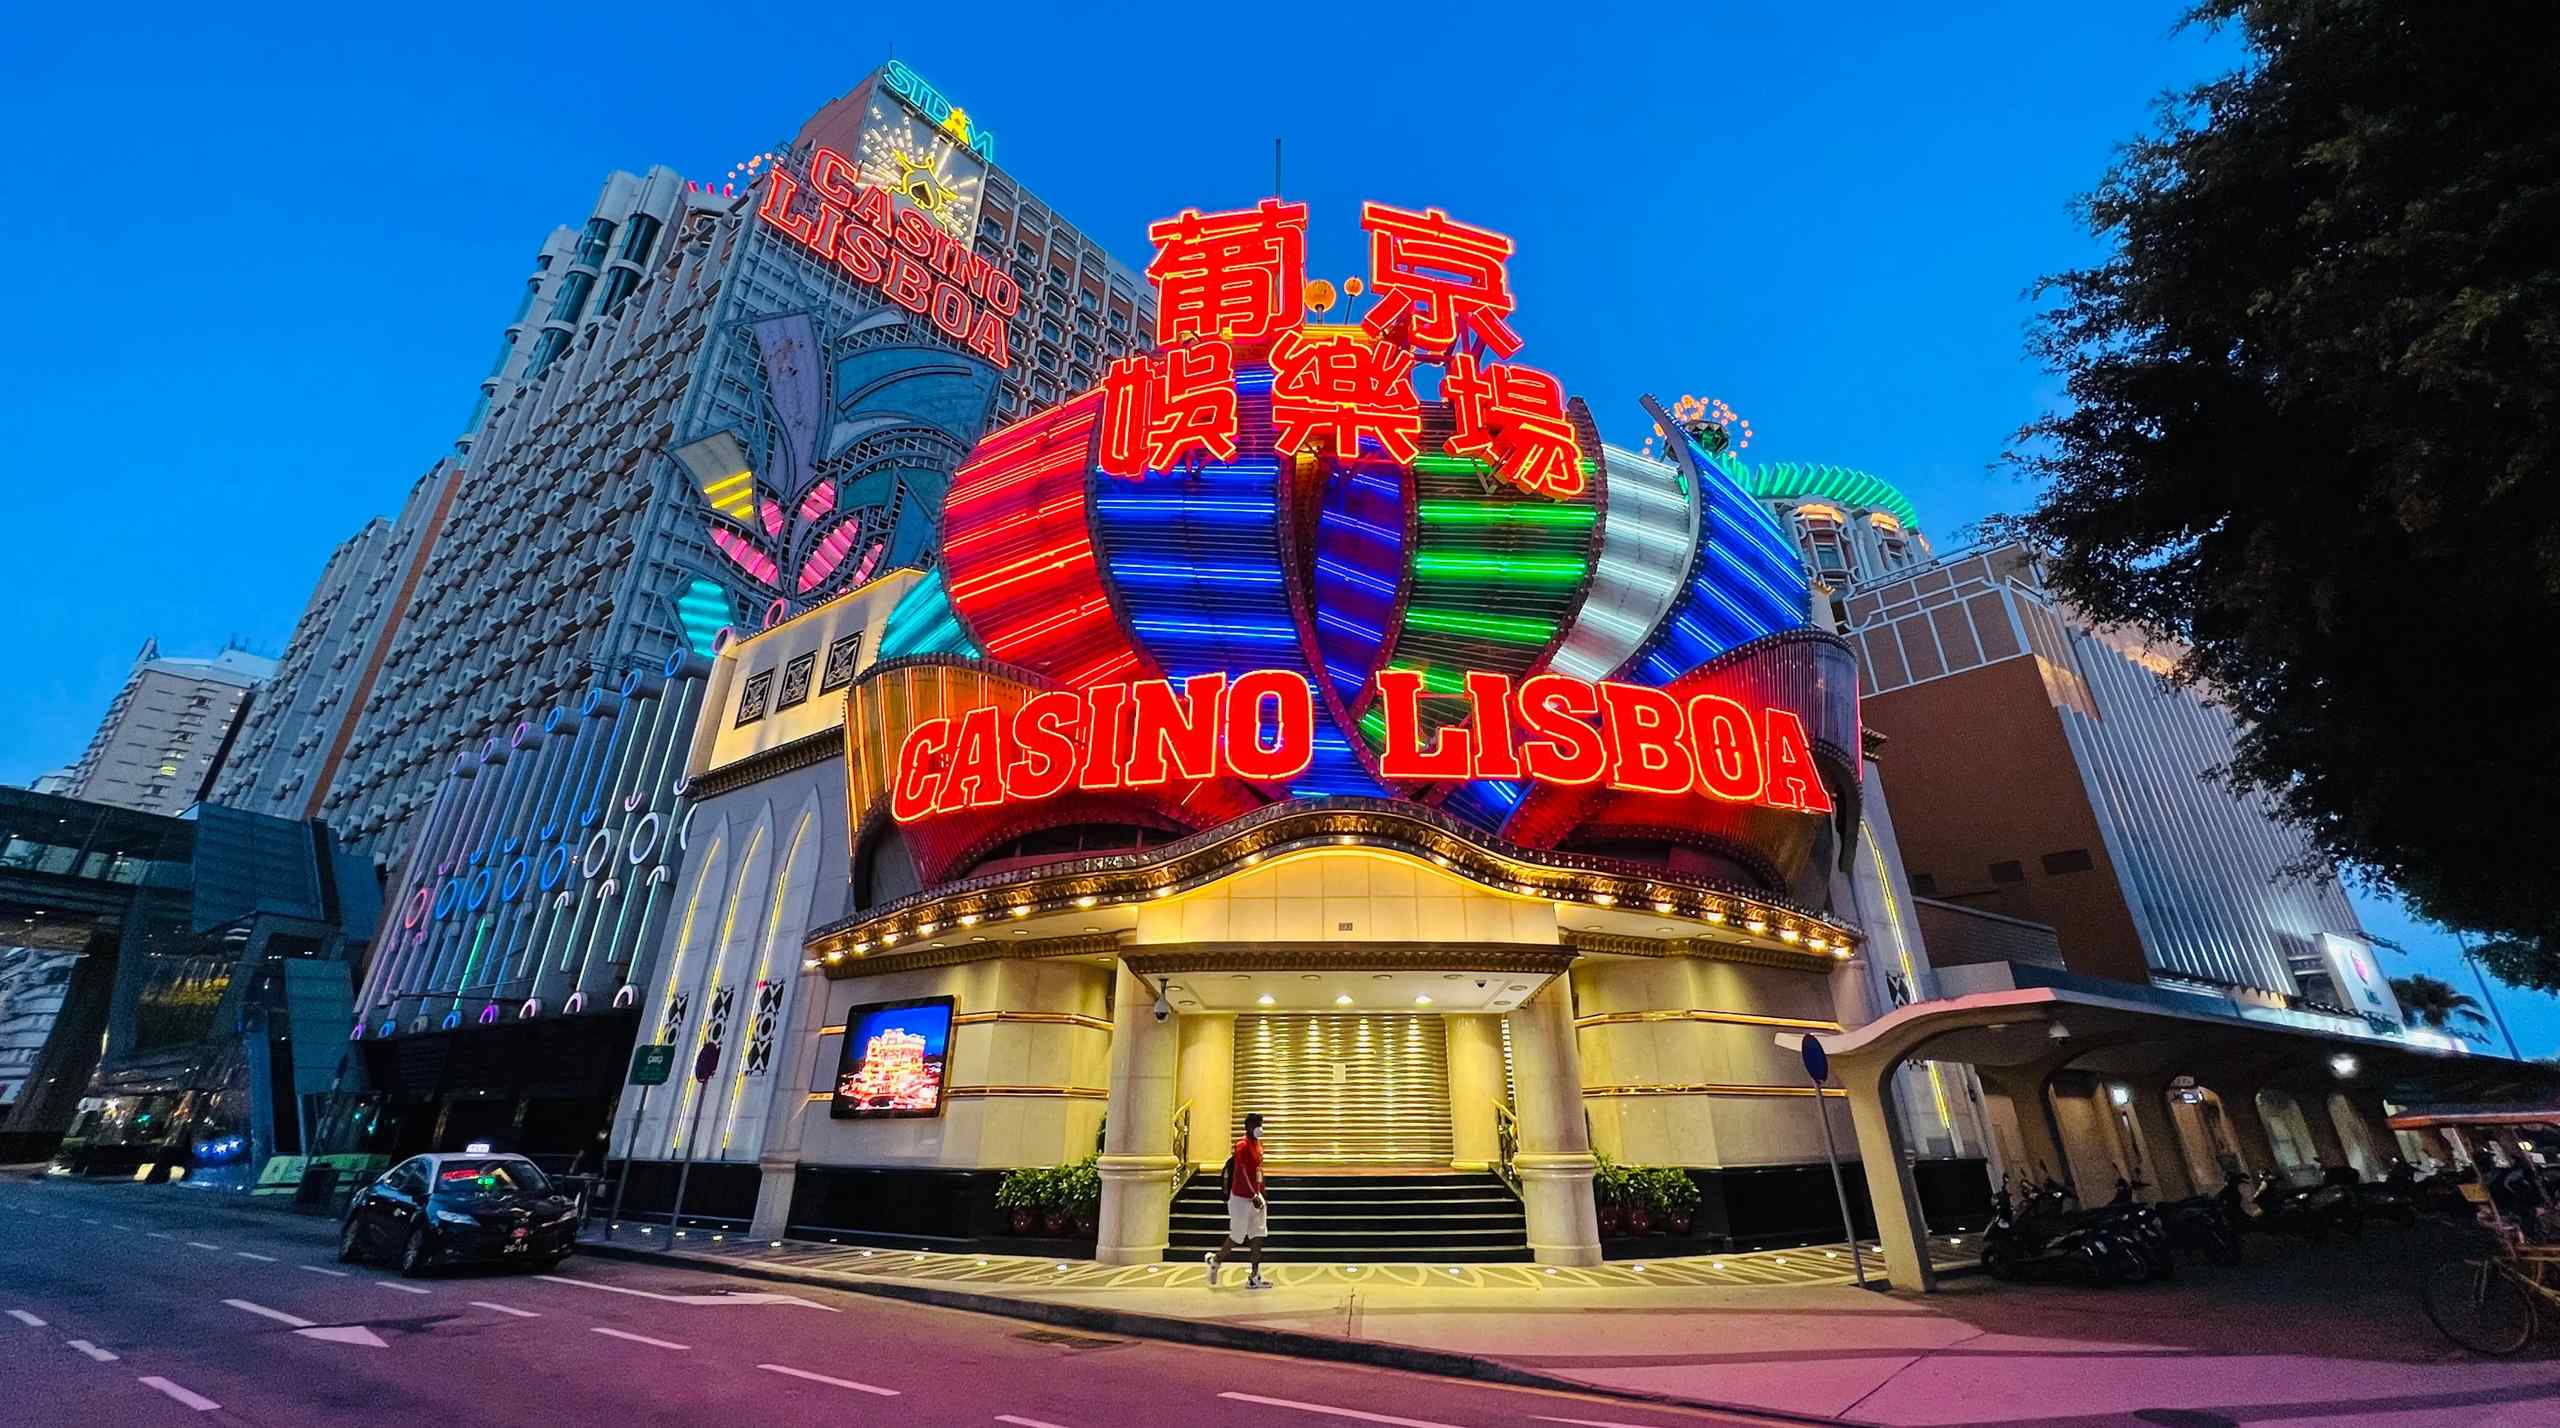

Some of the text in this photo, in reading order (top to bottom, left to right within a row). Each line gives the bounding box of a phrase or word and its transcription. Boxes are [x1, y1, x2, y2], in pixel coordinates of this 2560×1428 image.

[759, 167, 1010, 369] LISBOA
[810, 148, 1021, 317] CASINO
[1146, 198, 1523, 359] 葡京
[891, 669, 1833, 822] CASINO LISBOA
